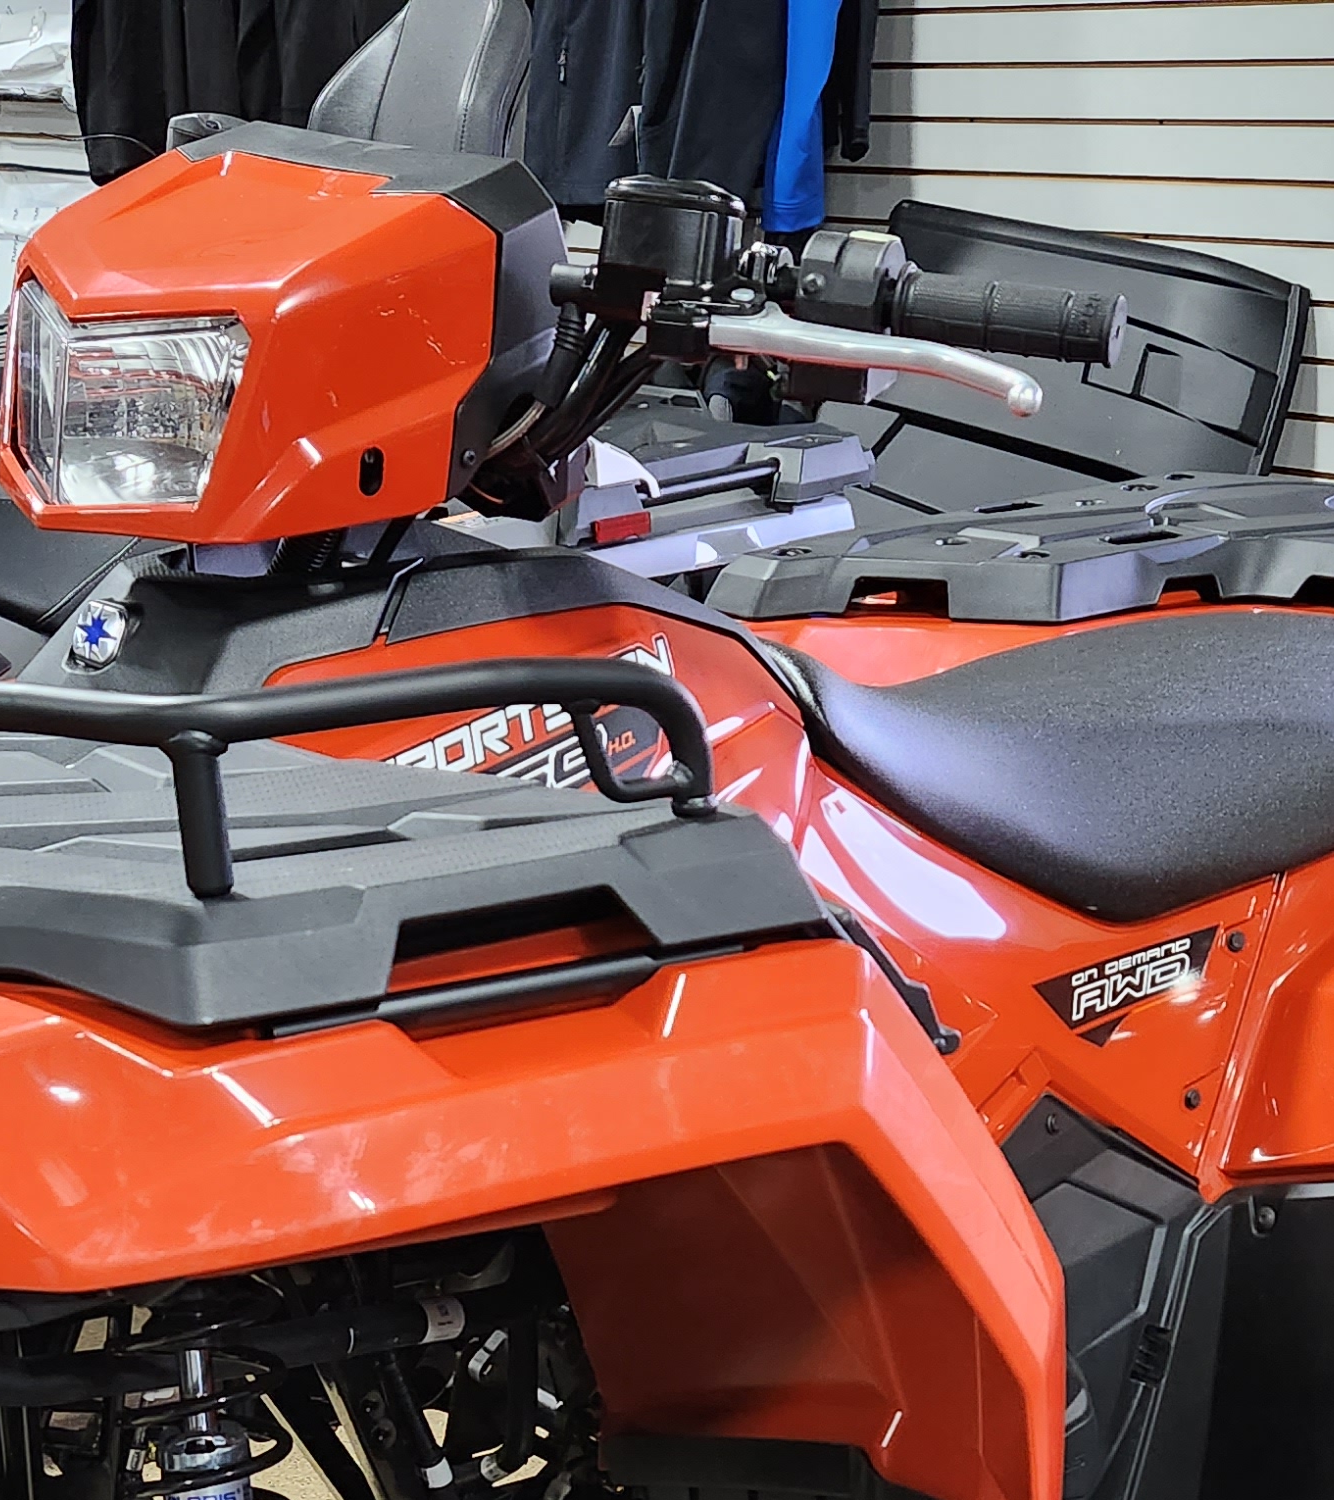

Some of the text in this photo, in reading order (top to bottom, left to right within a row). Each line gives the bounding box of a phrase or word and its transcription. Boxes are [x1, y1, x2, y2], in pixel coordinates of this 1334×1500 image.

[1071, 937, 1191, 987] ON DEMAND
[1071, 952, 1191, 1021] AWD
